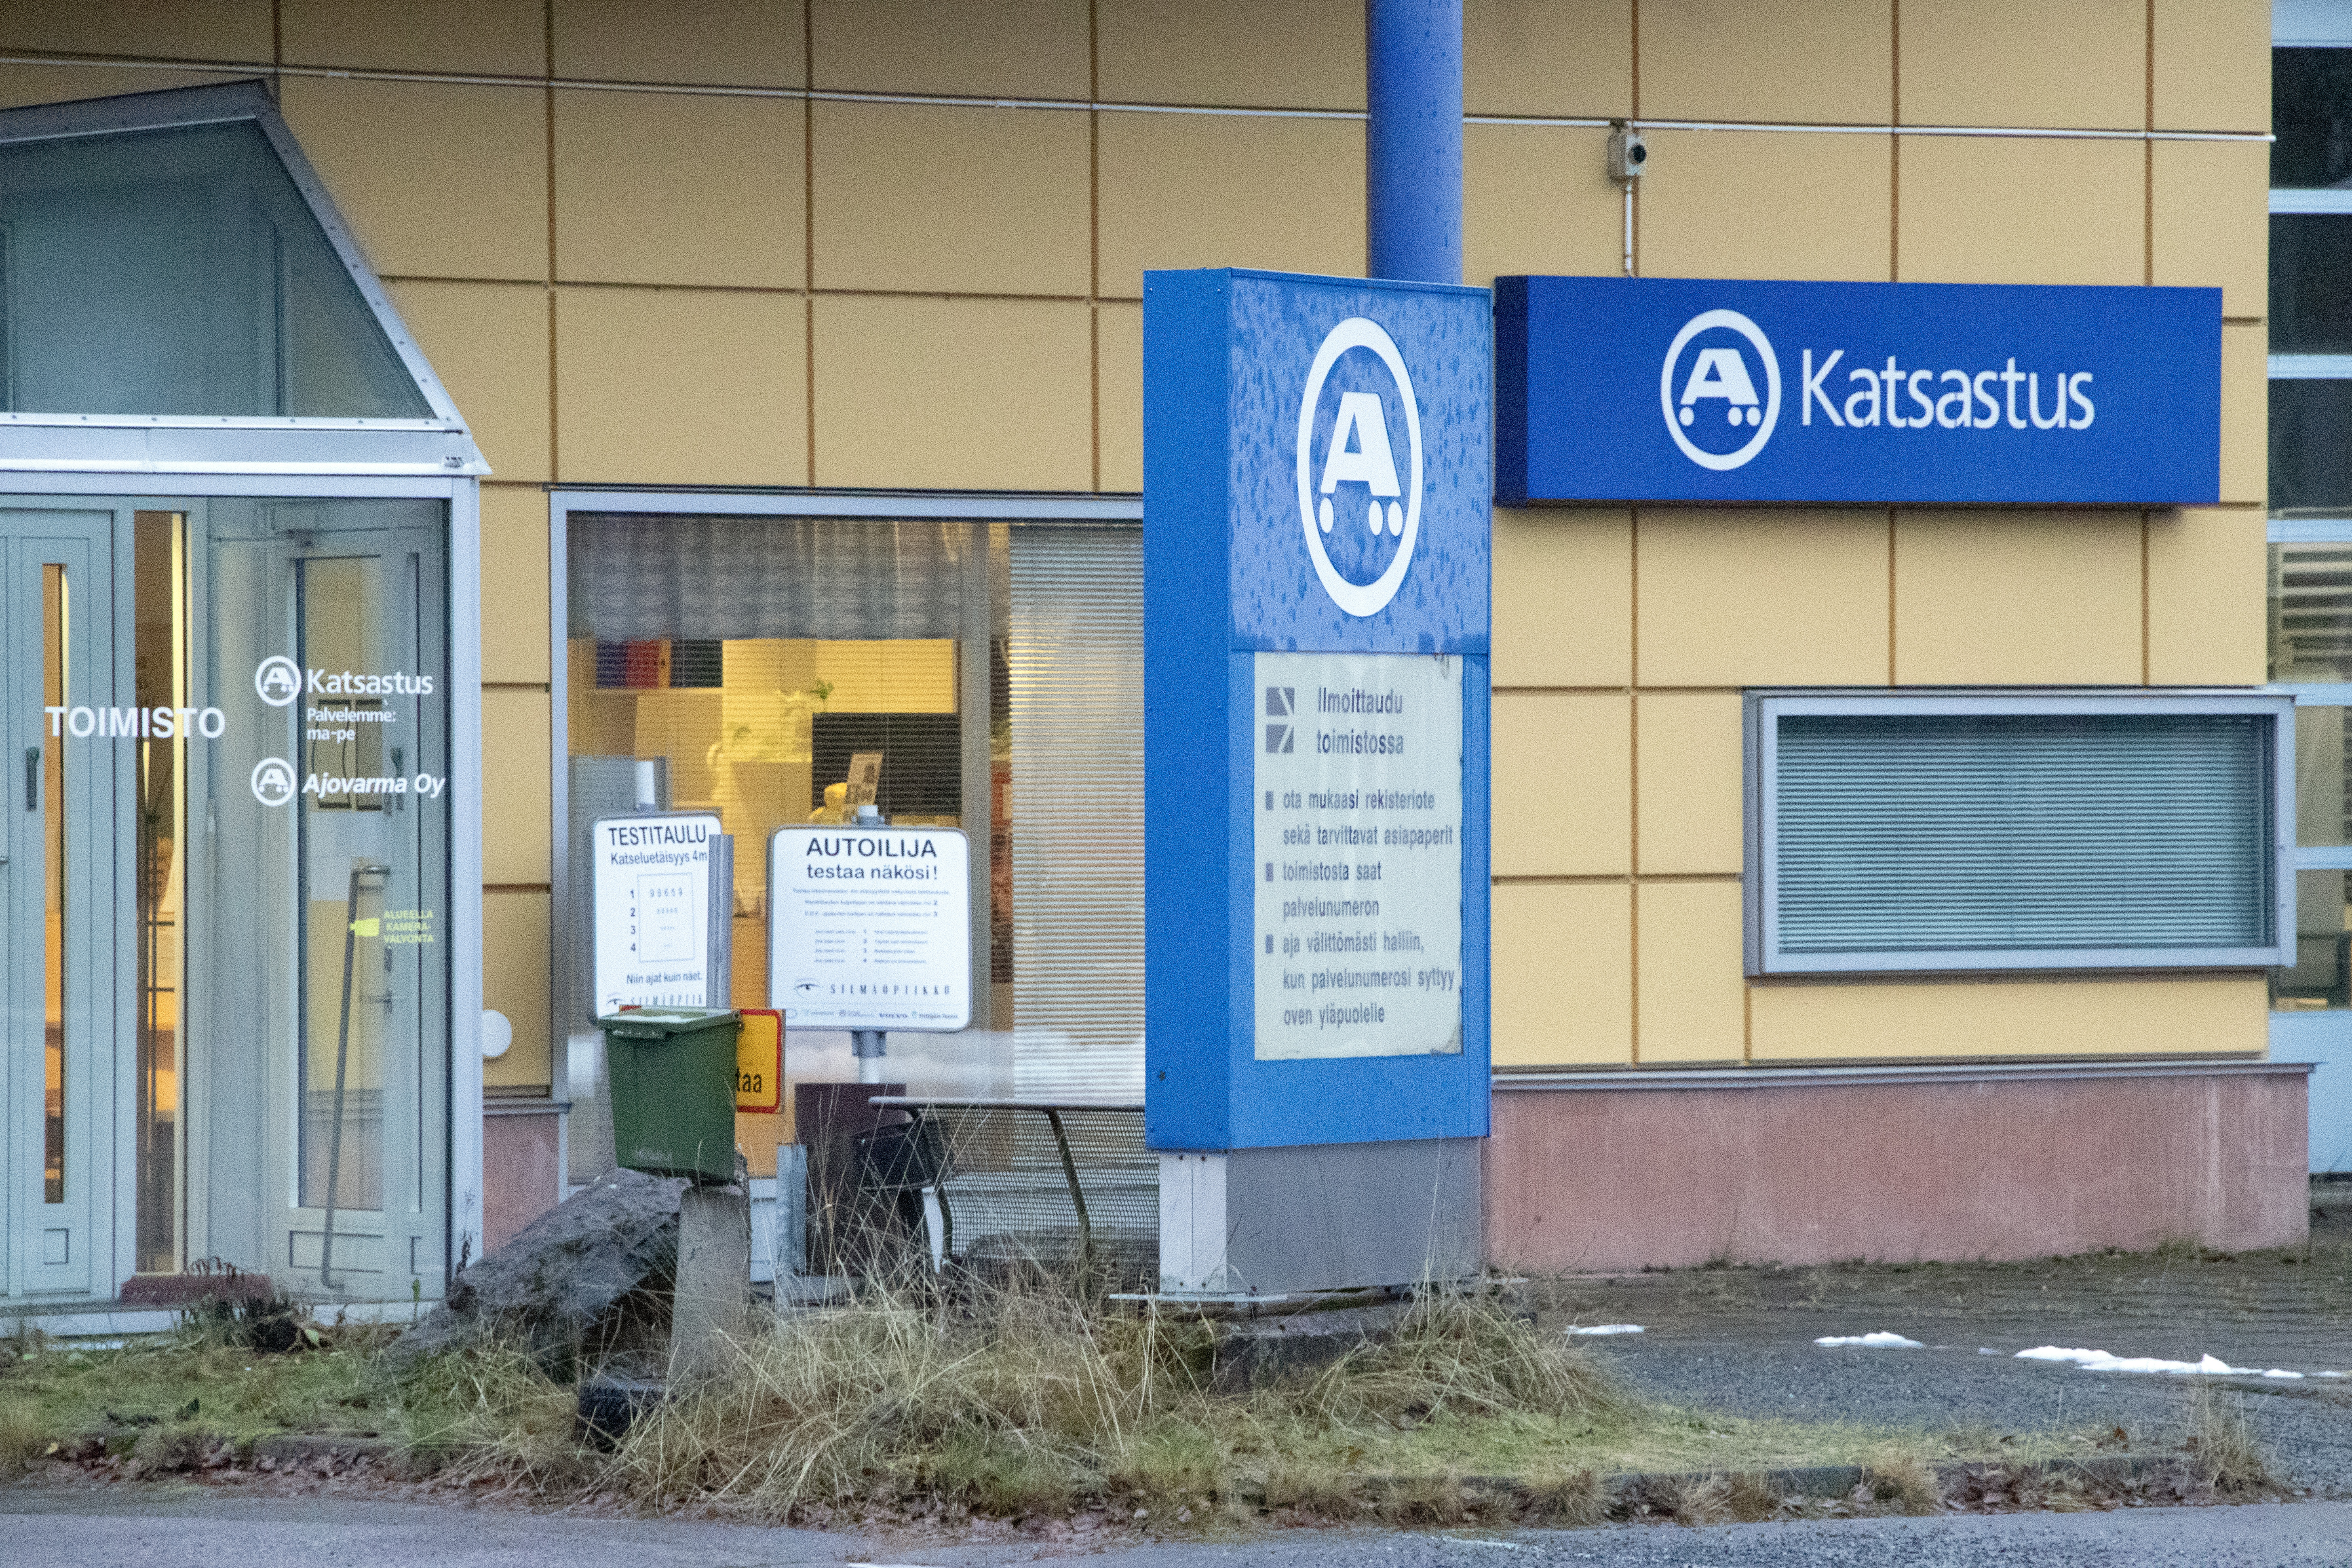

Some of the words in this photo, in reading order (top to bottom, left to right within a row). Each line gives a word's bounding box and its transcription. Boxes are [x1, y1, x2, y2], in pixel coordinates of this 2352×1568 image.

[1802, 348, 2095, 430] Katsastus
[307, 668, 434, 694] Katsastus
[1318, 687, 1403, 714] Ilmoittaudu
[44, 706, 226, 739] TOIMISTO
[306, 707, 397, 723] Palvelemme:
[306, 727, 356, 743] ma-pe
[1317, 729, 1404, 754] toimistossa
[302, 772, 407, 798] Ajovarma
[414, 773, 446, 798] Oy
[1283, 789, 1301, 809] ota
[1309, 789, 1359, 809] mukaasi
[1365, 789, 1435, 809] rekisteriote
[608, 825, 707, 846] TESTITAULU
[1283, 823, 1310, 845] sekä
[1317, 825, 1378, 845] tarvittavat
[1384, 825, 1453, 850] asiapaperit
[610, 850, 690, 866] Katseluetäisyys
[806, 837, 937, 858] AUTOILIJA
[806, 864, 865, 879] testaa
[870, 864, 938, 880] näkösi!
[1283, 861, 1349, 881] toimistosta
[1356, 861, 1382, 881] saat
[629, 889, 635, 898] 1
[630, 907, 636, 917] 2
[1283, 897, 1380, 922] palvelunumeron
[631, 925, 637, 935] 3
[630, 943, 637, 952] 4
[1283, 935, 1300, 958] aja
[1307, 931, 1377, 954] välittömästi
[1383, 931, 1424, 954] halliin,
[626, 973, 643, 984] Niin
[645, 973, 662, 986] ajat
[663, 972, 681, 983] kuin
[1283, 969, 1305, 989] kun
[1311, 967, 1411, 994] palvelunumerosi
[1418, 967, 1455, 991] syttyy
[1283, 1008, 1312, 1026] oven
[1319, 1003, 1385, 1030] yläpuolelle
[735, 1066, 762, 1093] taa
